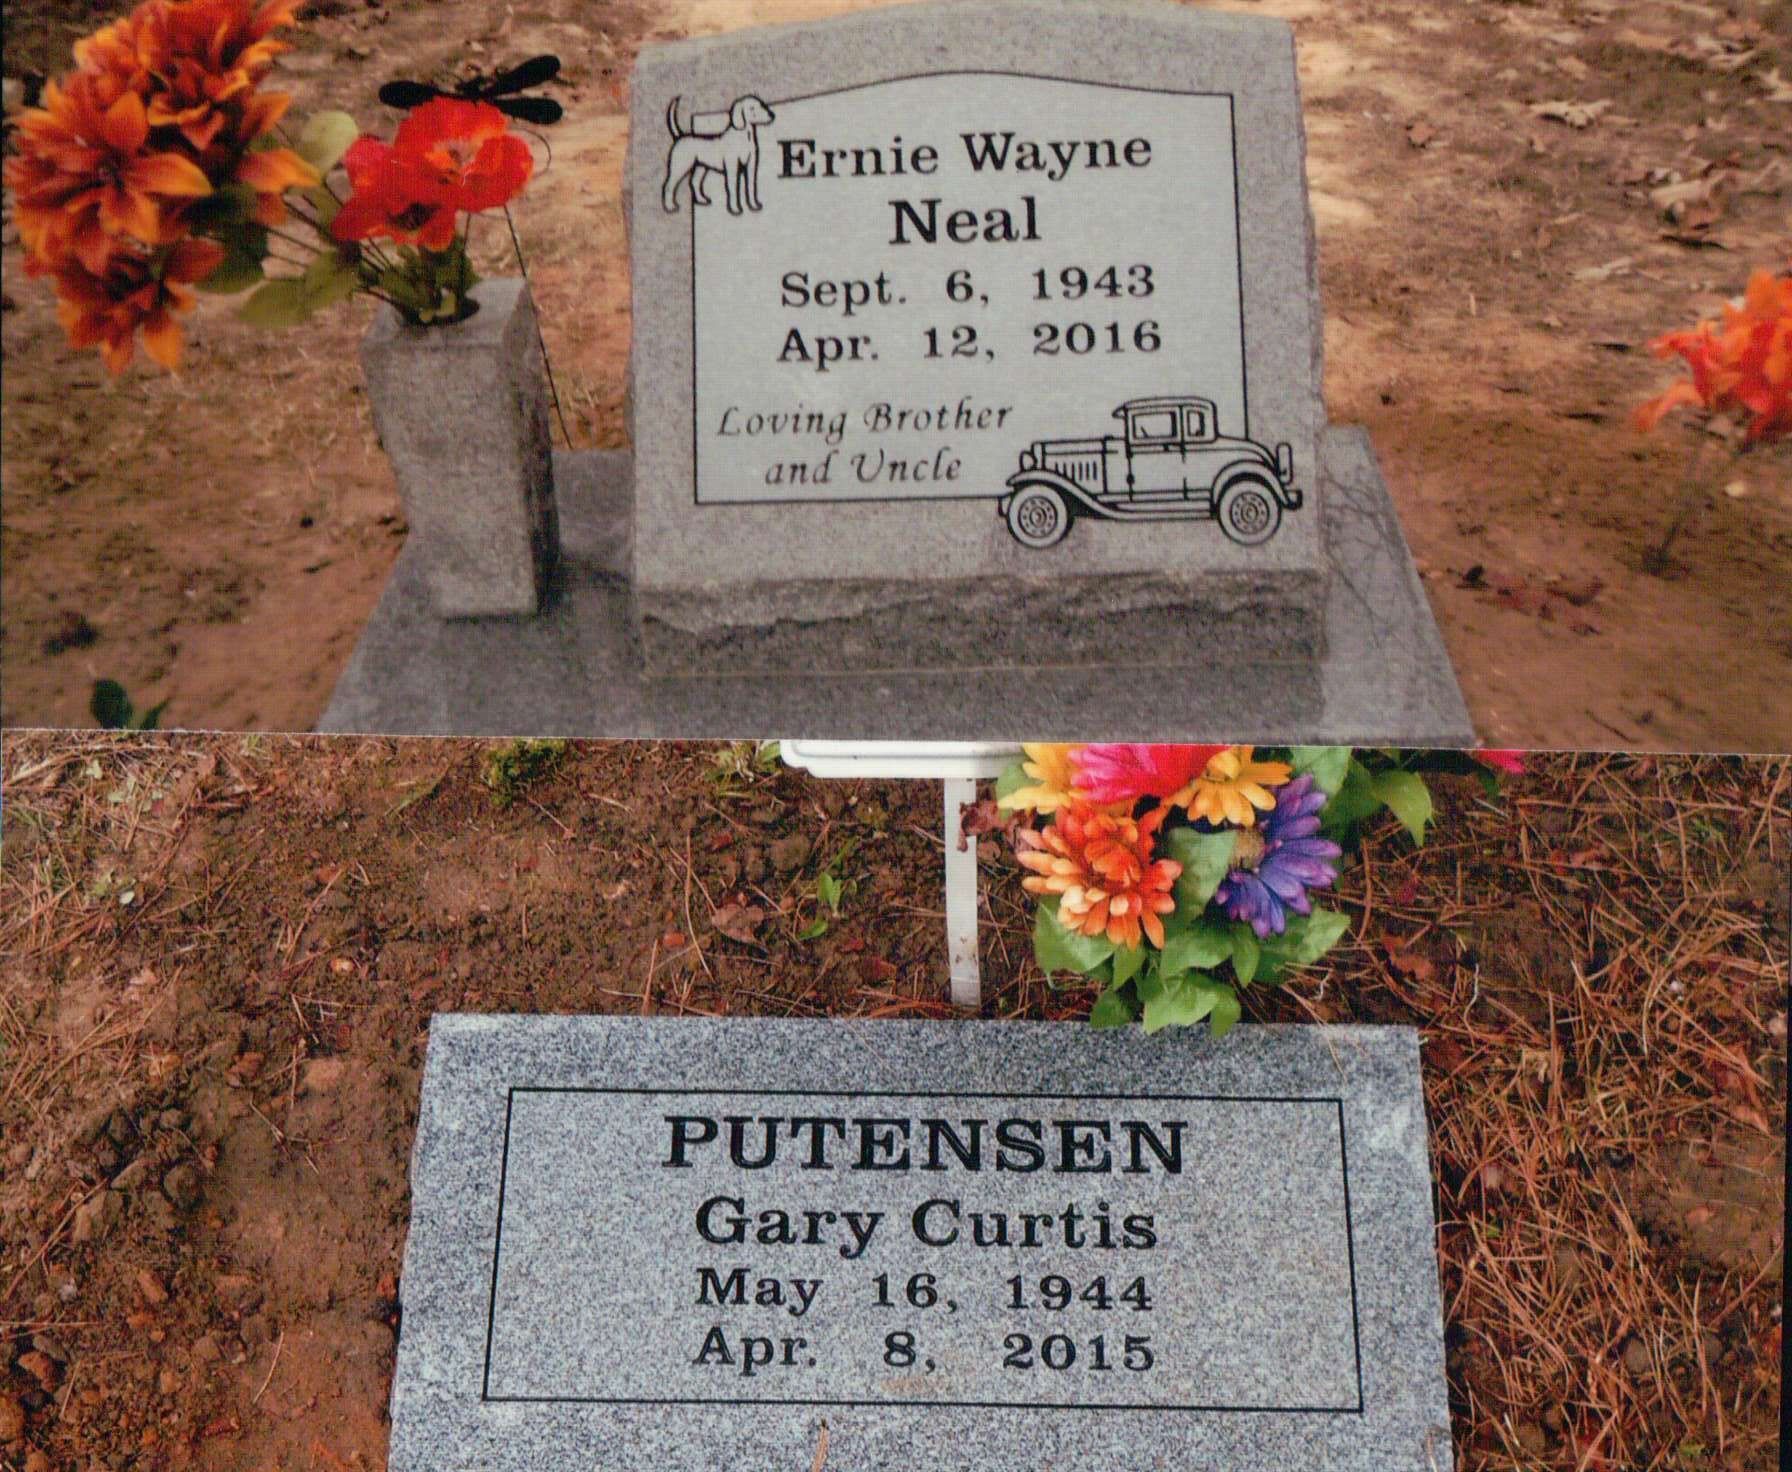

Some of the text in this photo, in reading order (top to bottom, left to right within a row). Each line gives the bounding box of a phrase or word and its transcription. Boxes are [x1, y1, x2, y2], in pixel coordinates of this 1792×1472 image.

[778, 131, 1152, 181] Ernie Wayne
[888, 196, 1042, 246] Neal
[781, 265, 1155, 315] Sept. 6, 1943
[778, 320, 1161, 371] Apr. 12, 2016
[717, 397, 1014, 444] Loving Brother
[765, 446, 963, 485] and Uncle
[662, 1115, 1189, 1175] PUTENSEN
[695, 1195, 1158, 1259] Gary Curtis
[695, 1267, 1153, 1317] May 16, 1944
[692, 1326, 1154, 1377] Apr. 8, 2015
